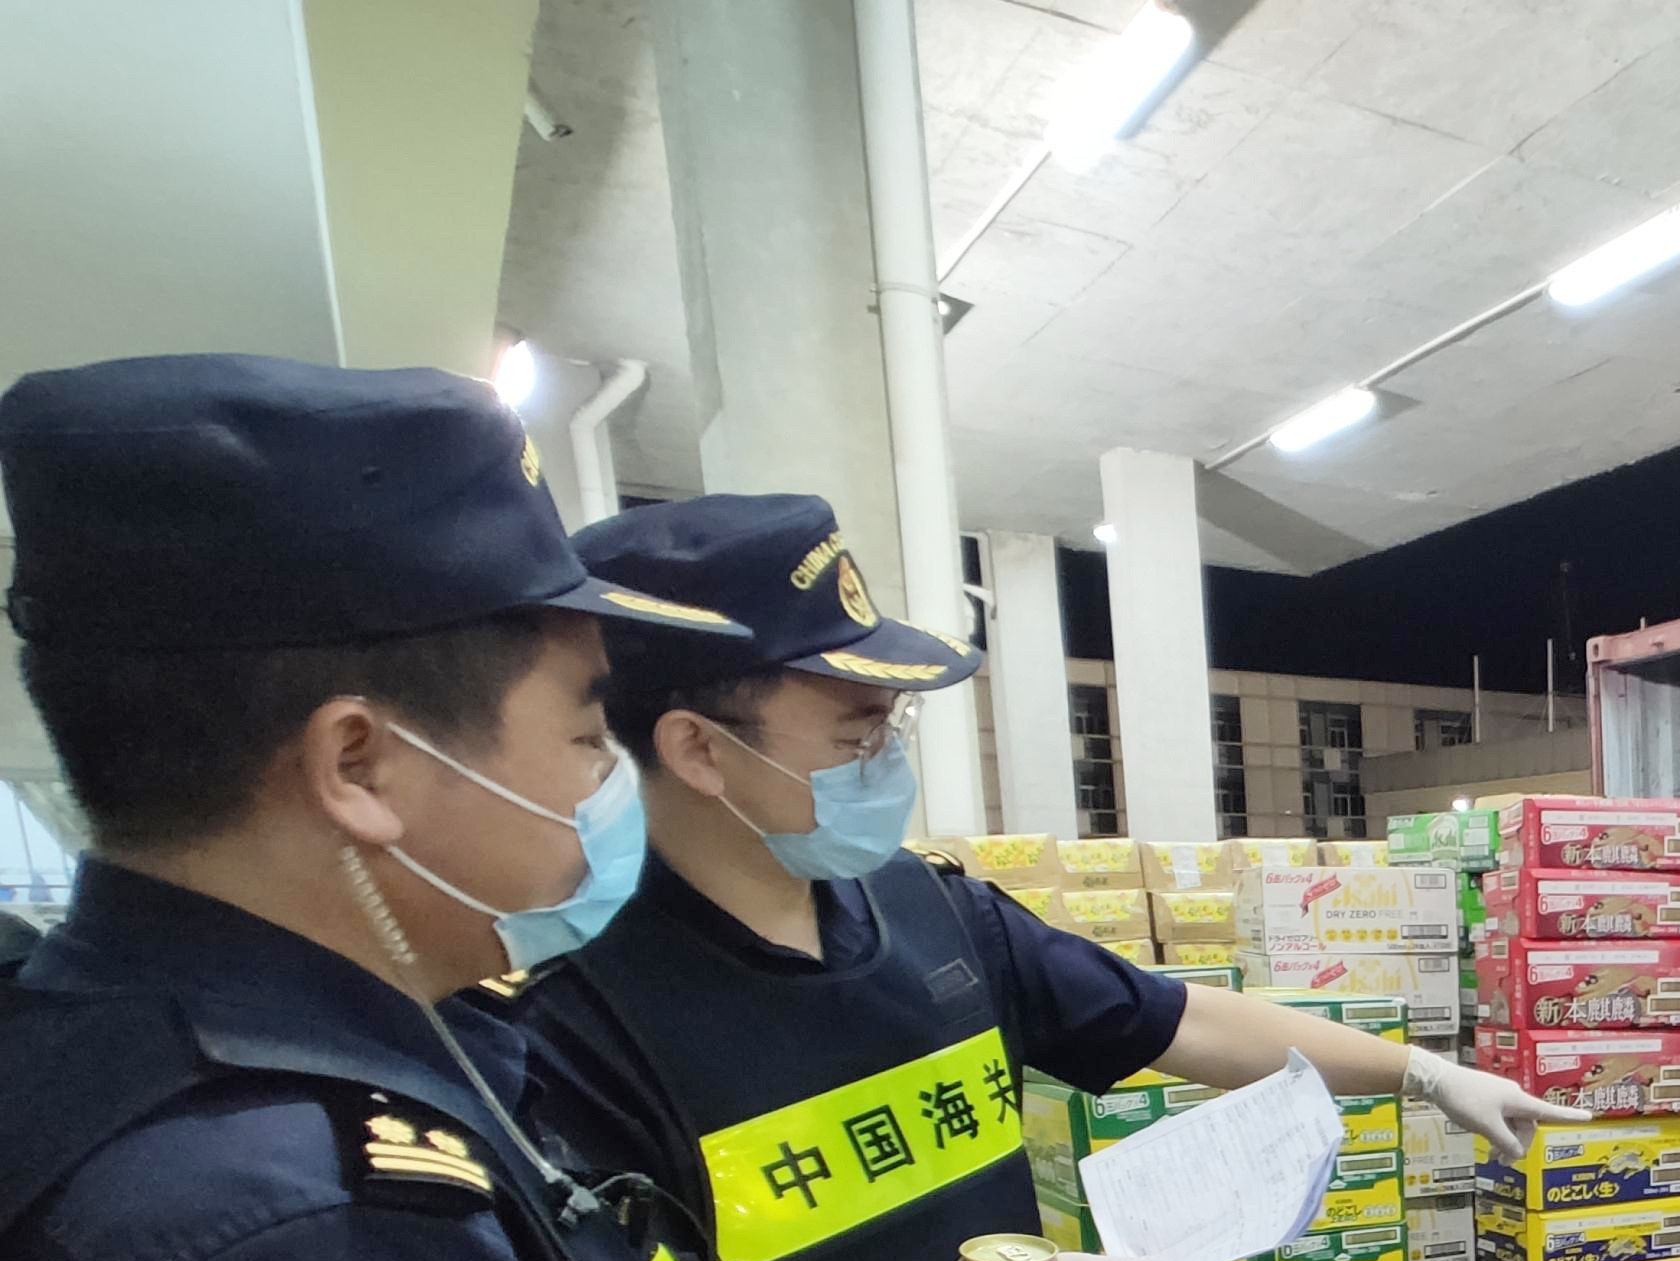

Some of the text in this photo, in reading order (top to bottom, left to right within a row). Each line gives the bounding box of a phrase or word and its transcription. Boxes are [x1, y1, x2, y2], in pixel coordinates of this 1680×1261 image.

[790, 541, 836, 590] CHINA
[1326, 910, 1346, 919] DRY
[1349, 910, 1376, 919] ZERO
[760, 1058, 1022, 1210] 中国海关
